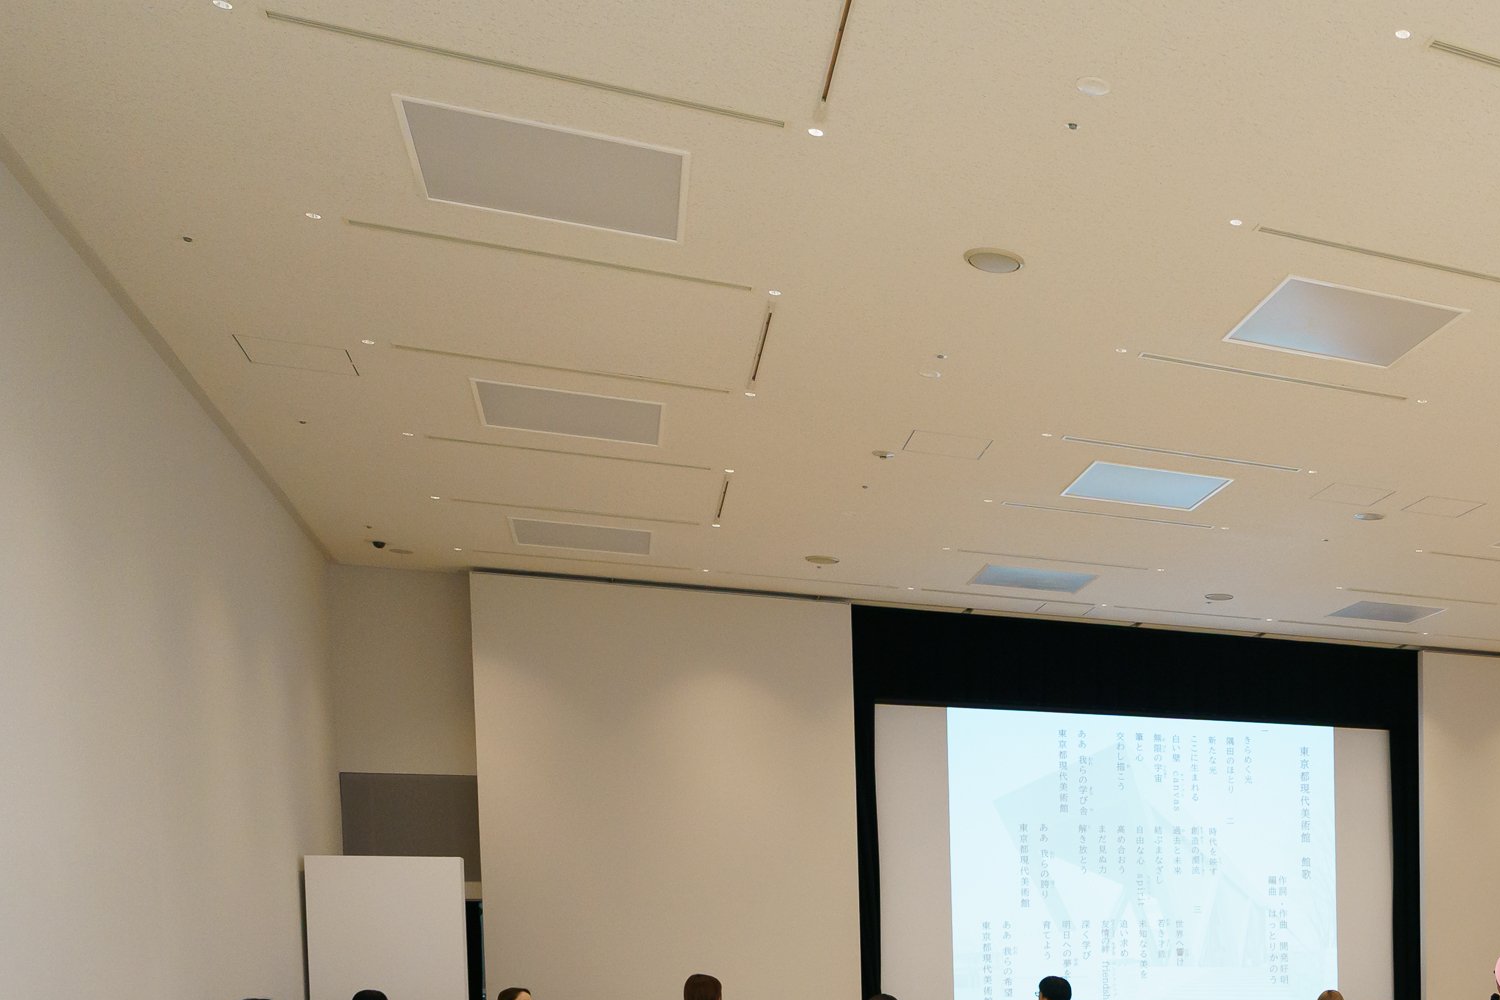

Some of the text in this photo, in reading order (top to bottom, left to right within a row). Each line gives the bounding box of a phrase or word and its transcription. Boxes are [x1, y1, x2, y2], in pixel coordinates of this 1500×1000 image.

[1058, 729, 1068, 813] 東京都現代美術館
[1300, 746, 1310, 843] 東京都現代美術館
[1020, 823, 1030, 908] 東京都現代美術館
